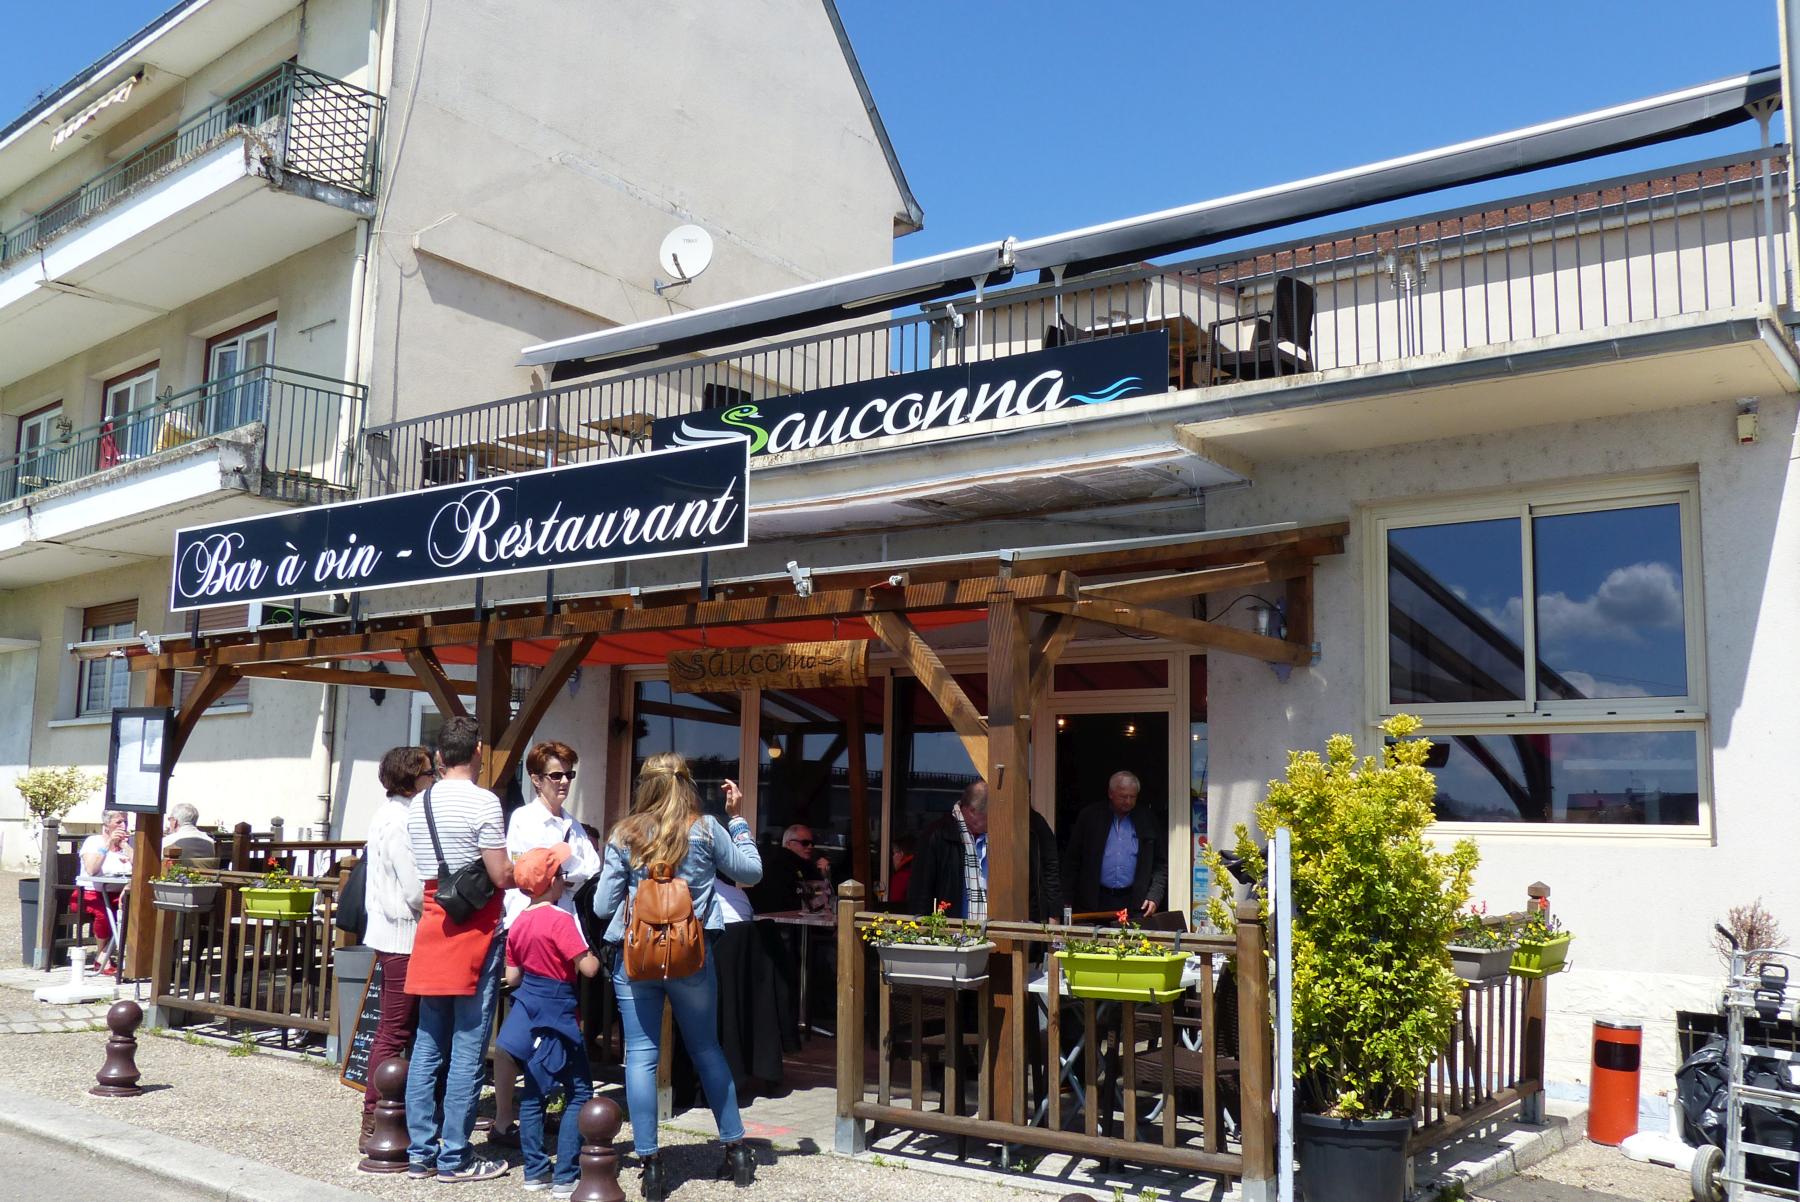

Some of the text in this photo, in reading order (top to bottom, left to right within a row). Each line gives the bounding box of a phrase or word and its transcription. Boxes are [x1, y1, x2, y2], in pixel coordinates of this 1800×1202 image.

[719, 369, 1071, 456] Sauconna
[178, 532, 269, 598] Bar
[276, 541, 307, 587] à
[314, 533, 383, 583] vin
[428, 475, 739, 568] Restaurant
